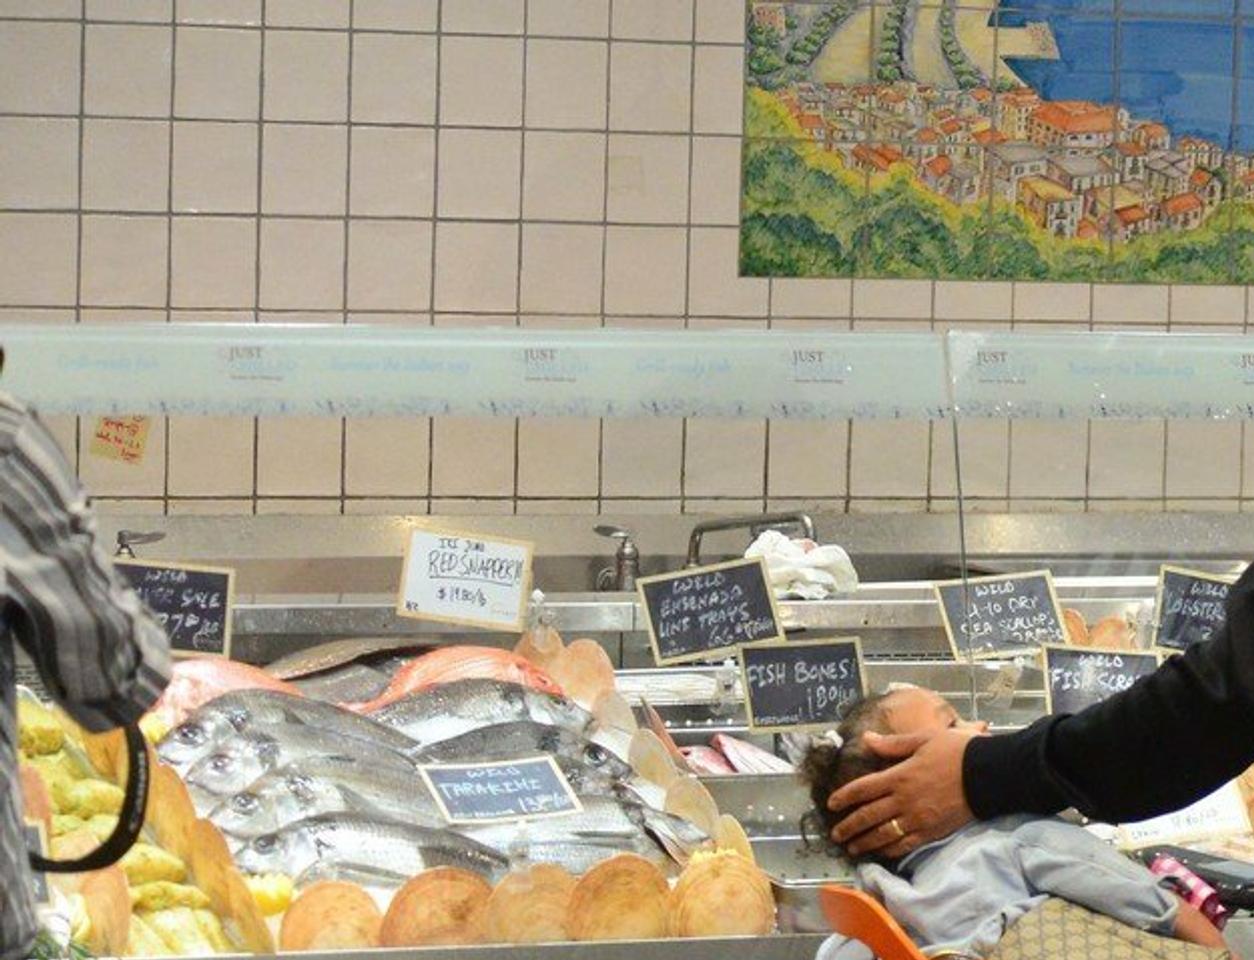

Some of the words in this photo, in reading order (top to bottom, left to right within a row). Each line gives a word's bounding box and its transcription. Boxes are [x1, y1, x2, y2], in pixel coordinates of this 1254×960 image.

[229, 347, 263, 361] JUST
[525, 349, 559, 361] JUST
[793, 350, 825, 363] JUST
[977, 351, 1008, 366] JUST
[428, 550, 458, 575] RED
[672, 572, 725, 594] WILD
[975, 580, 1015, 597] WILD
[747, 662, 786, 688] FISH
[466, 766, 521, 779] WILD
